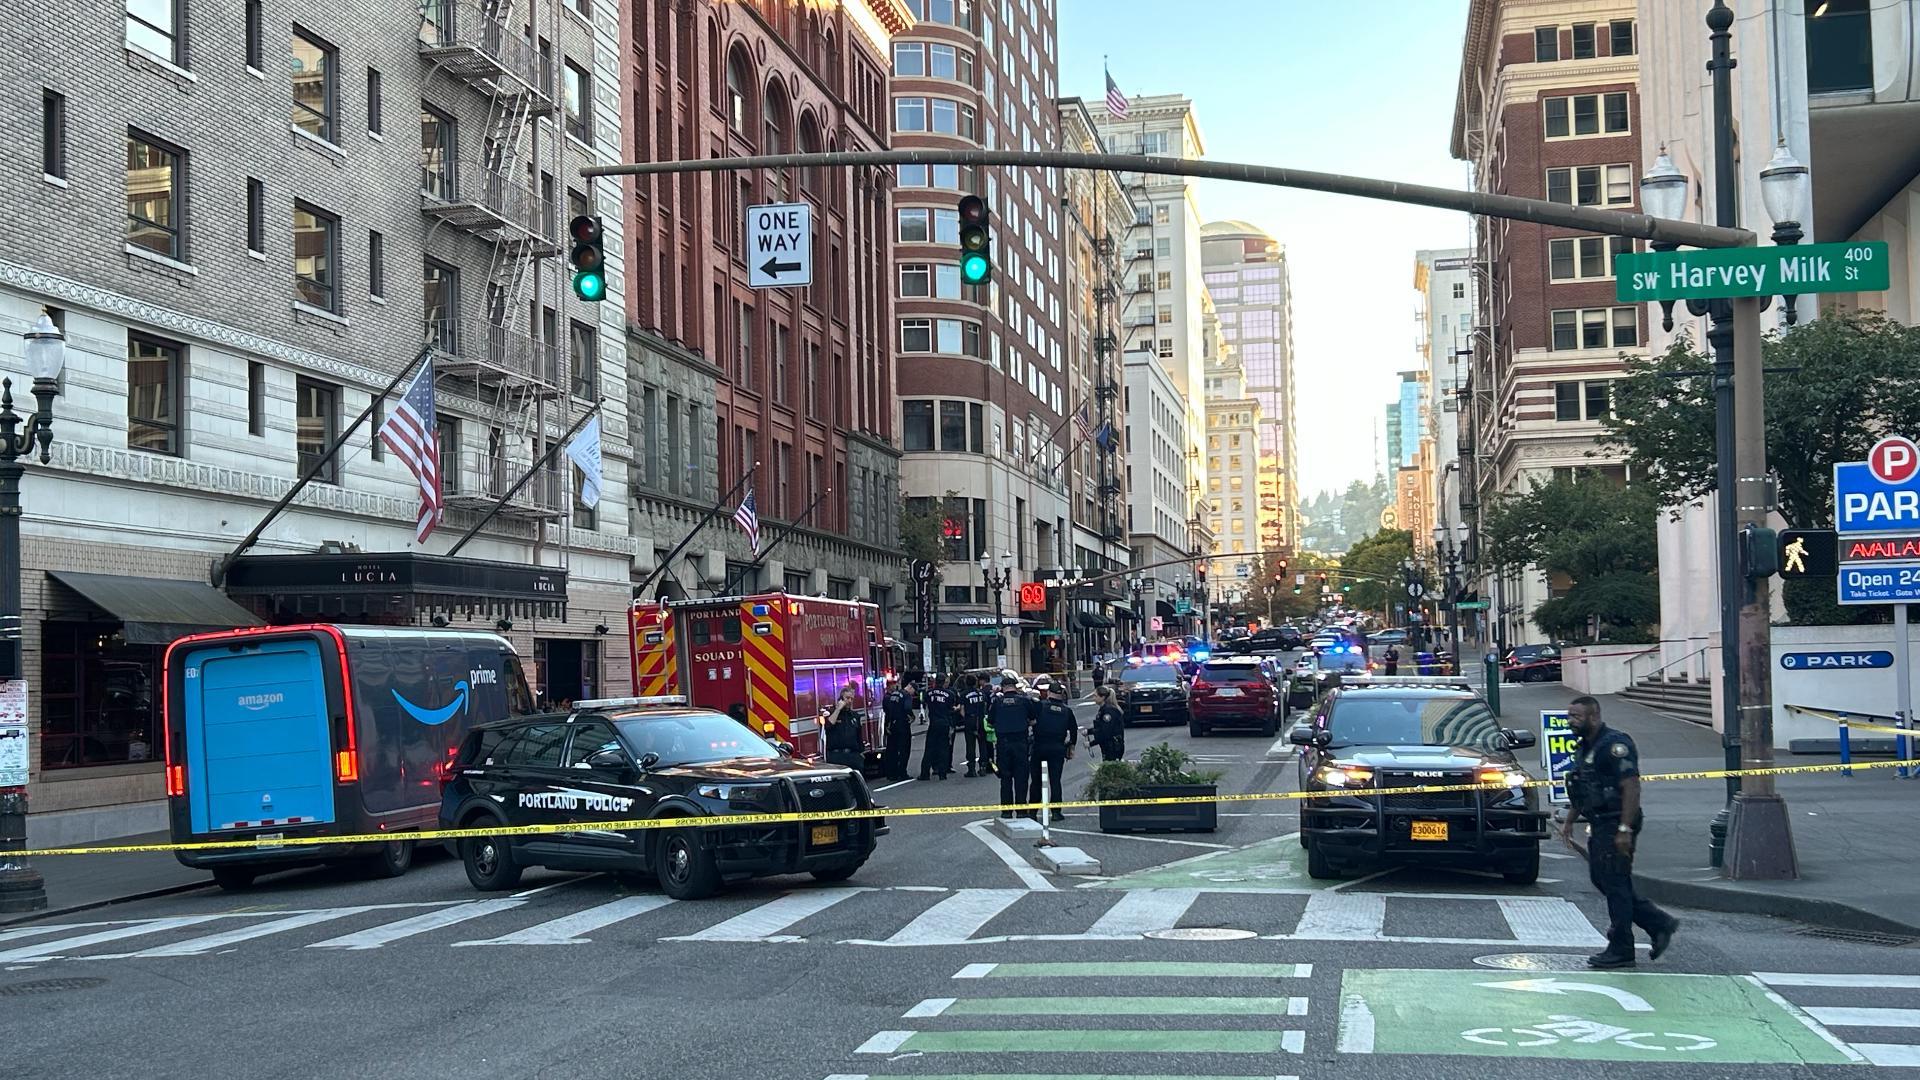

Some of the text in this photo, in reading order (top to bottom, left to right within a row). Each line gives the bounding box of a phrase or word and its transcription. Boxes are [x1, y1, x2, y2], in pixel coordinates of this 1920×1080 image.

[759, 211, 800, 230] ONE
[758, 232, 800, 252] WAY
[1844, 247, 1872, 262] 400
[1632, 256, 1830, 292] SW Harvey Milk
[1844, 266, 1860, 280] St
[1884, 446, 1910, 476] P
[1844, 490, 1919, 522] PAR
[1850, 542, 1920, 558] AVAILA
[342, 572, 396, 582] LUCIA
[1848, 571, 1893, 589] Open
[690, 608, 741, 620] PORTLAND
[695, 651, 734, 662] SQUAD
[1807, 655, 1872, 666] PARK
[470, 664, 496, 690] prime
[238, 692, 284, 706] amazon
[1550, 716, 1570, 727] Eve
[1550, 736, 1581, 754] Ho
[519, 793, 628, 812] PORTLAND POLICE
